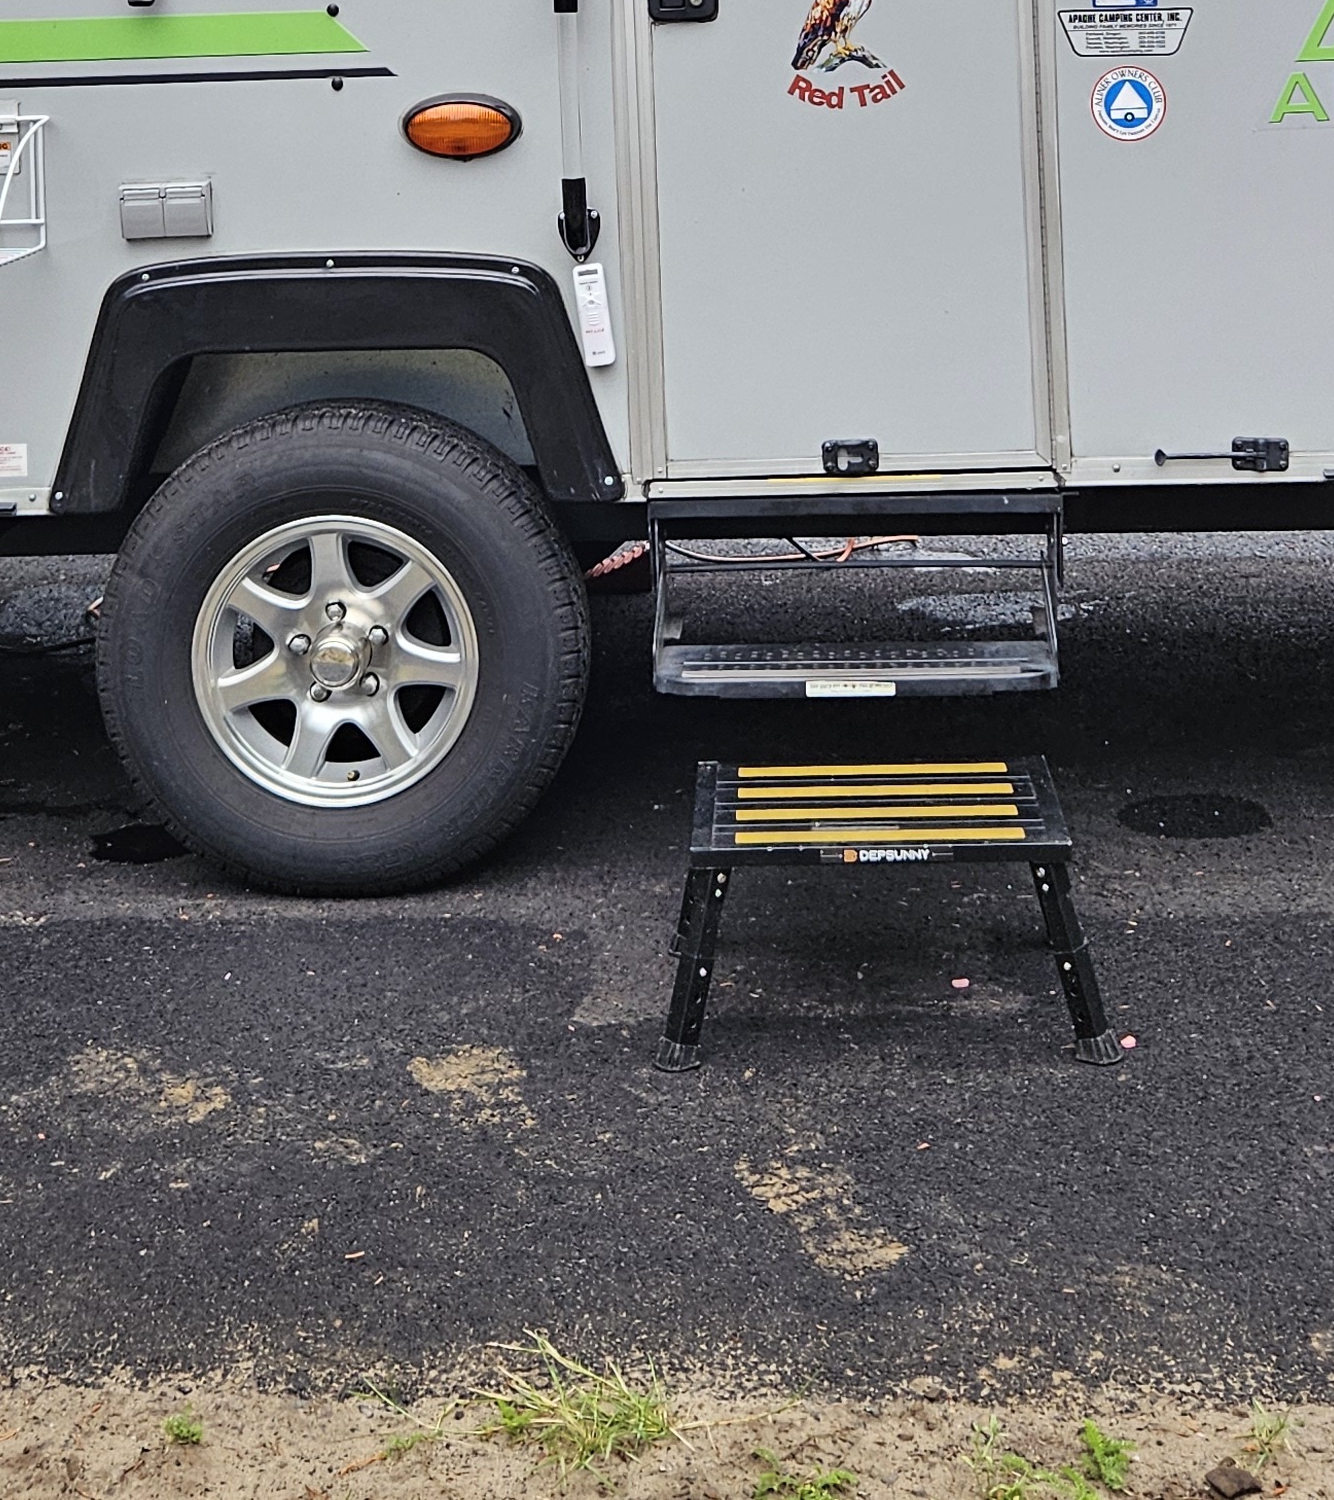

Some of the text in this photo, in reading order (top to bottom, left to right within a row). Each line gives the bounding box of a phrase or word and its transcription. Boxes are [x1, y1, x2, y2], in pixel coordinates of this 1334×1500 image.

[1068, 13, 1096, 23] APACHE
[1099, 13, 1133, 23] CAMPING
[787, 68, 906, 109] Red Tail
[1111, 69, 1149, 83] OWNERS
[1148, 80, 1163, 104] CLUB
[859, 849, 930, 862] DEPSUNNY
